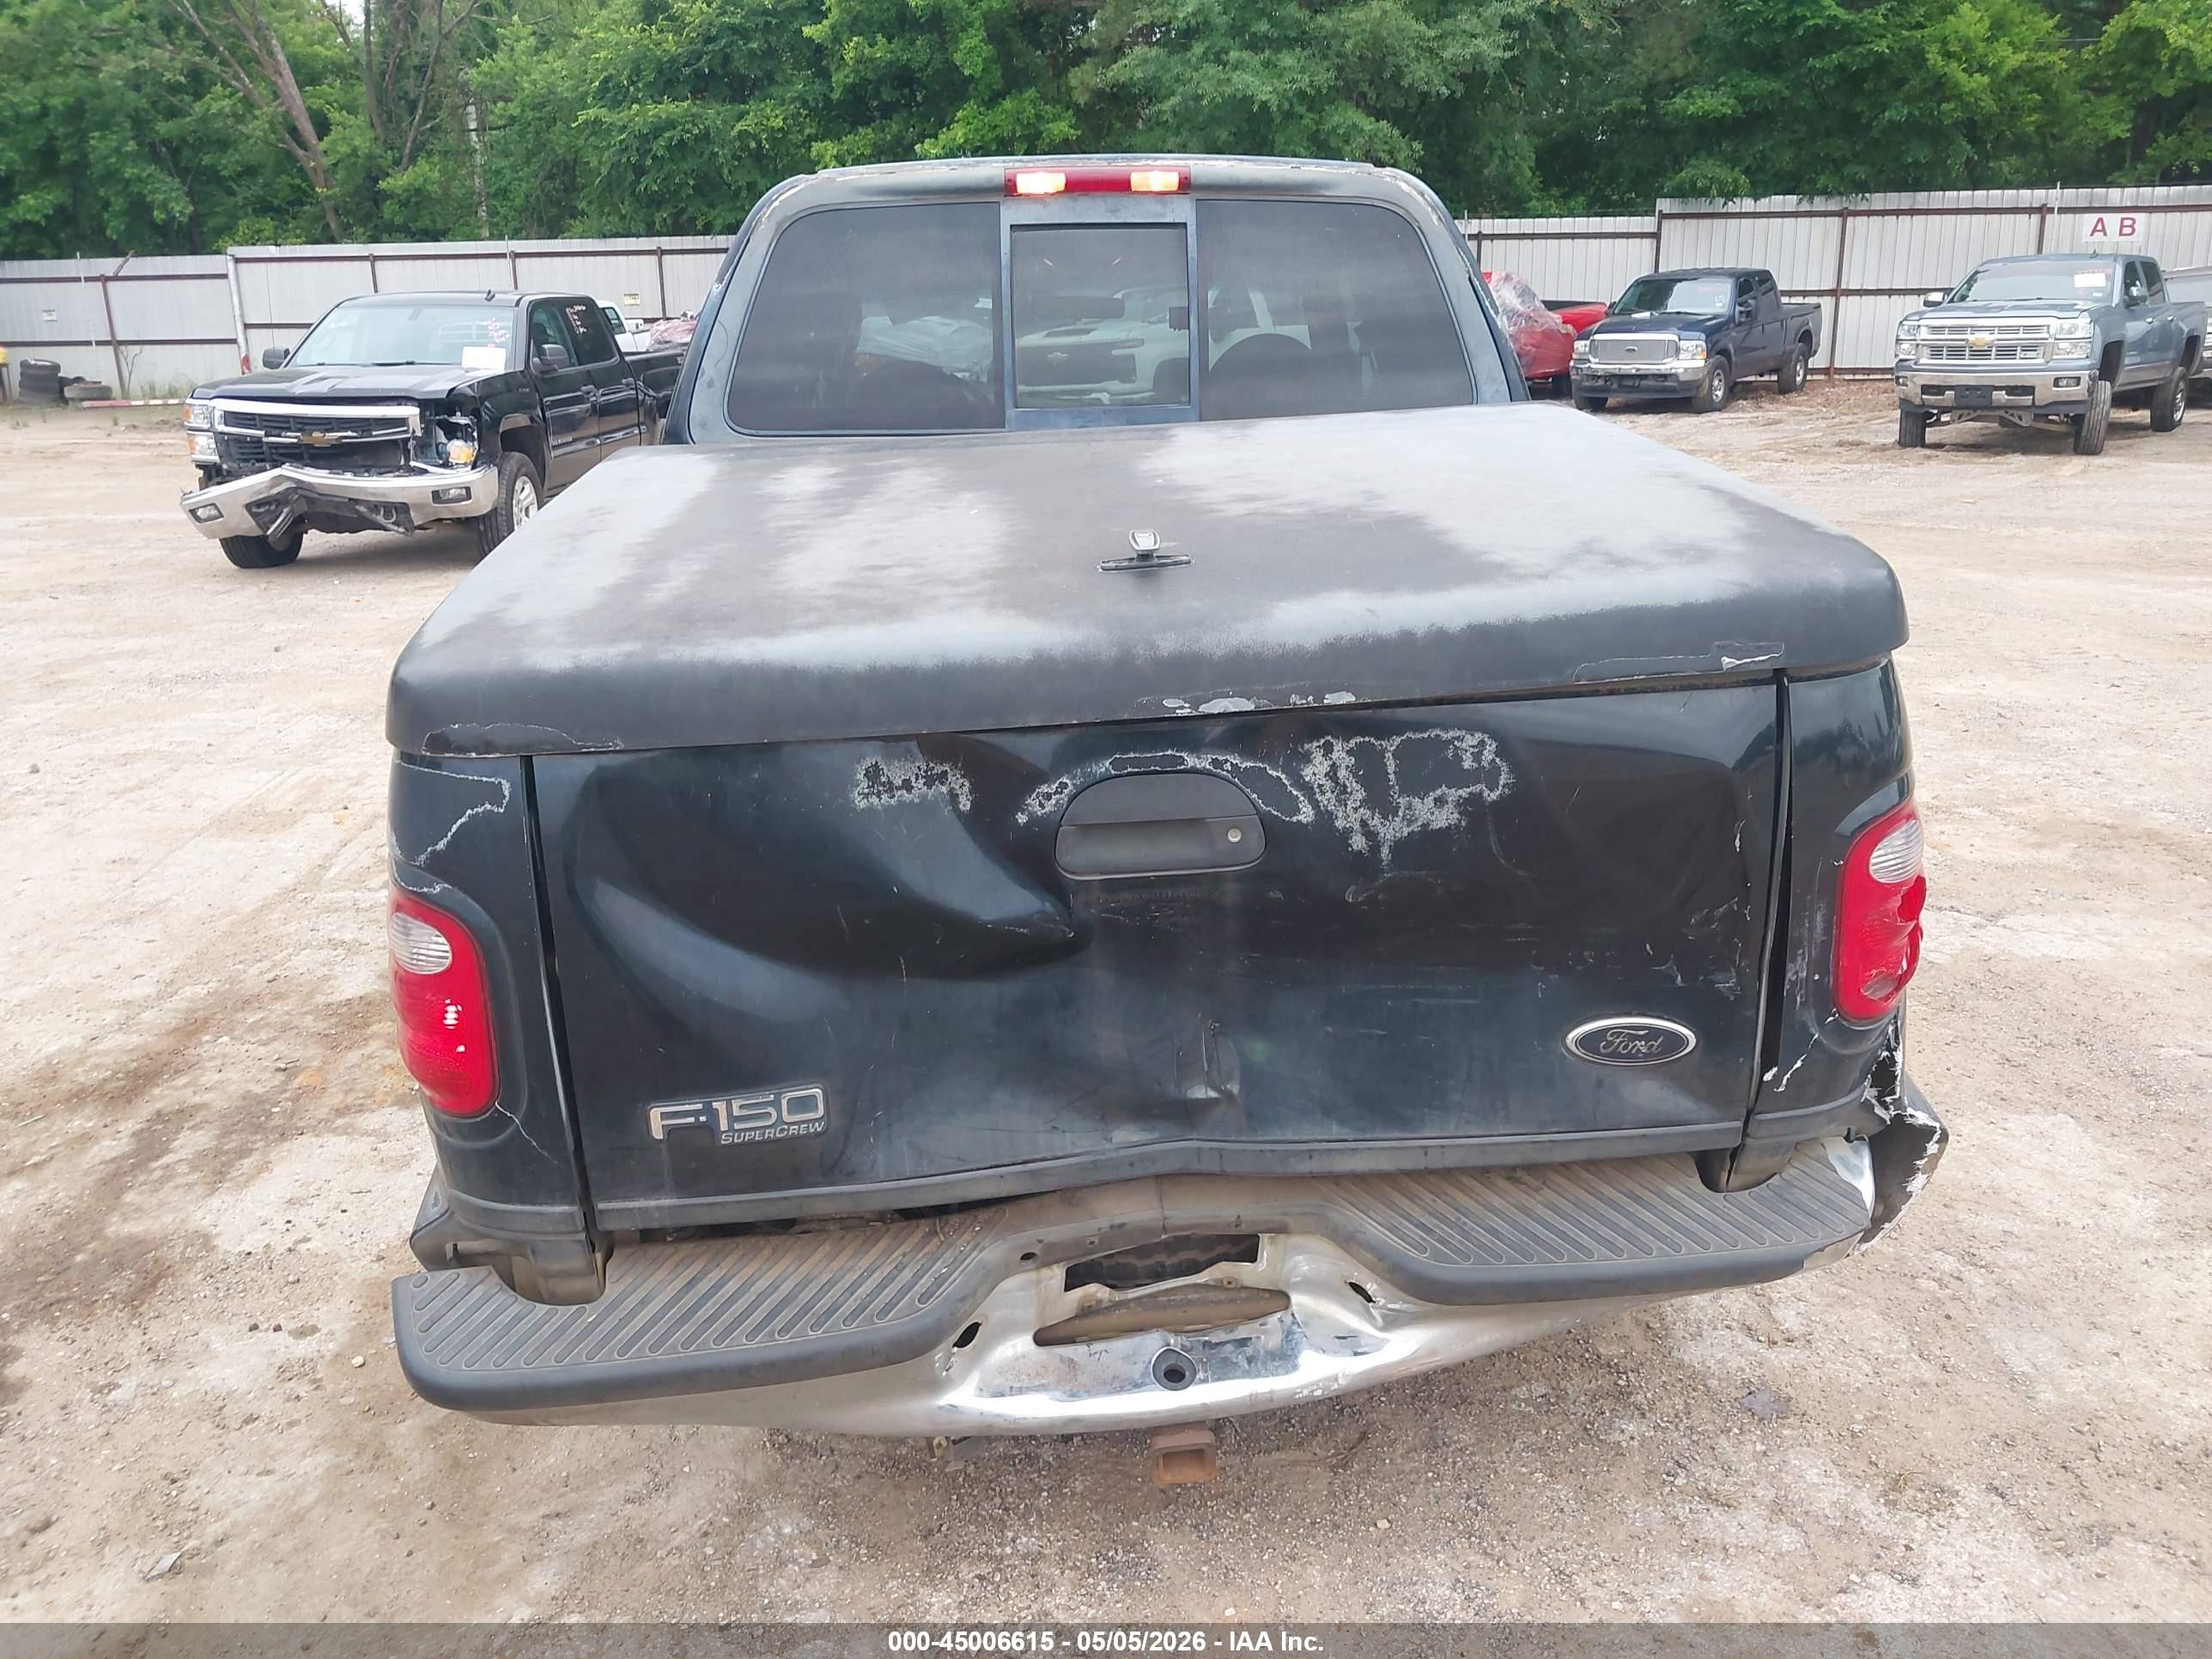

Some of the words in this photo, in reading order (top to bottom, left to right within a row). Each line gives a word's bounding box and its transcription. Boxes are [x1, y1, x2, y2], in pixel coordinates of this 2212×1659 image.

[2089, 216, 2108, 237] A
[2118, 216, 2137, 237] B
[1599, 1028, 1664, 1054] Ford
[648, 1087, 825, 1141] F-150
